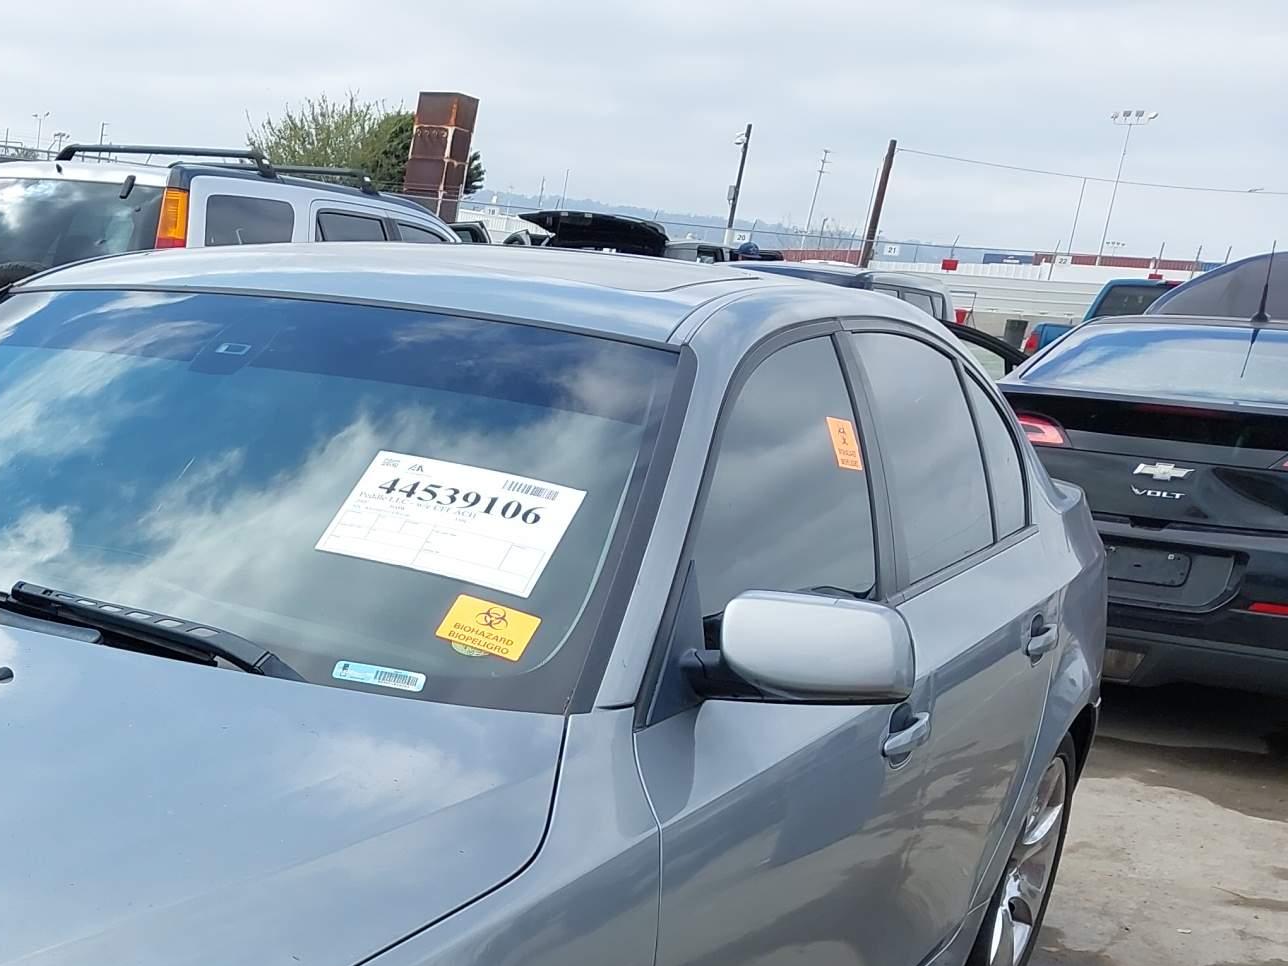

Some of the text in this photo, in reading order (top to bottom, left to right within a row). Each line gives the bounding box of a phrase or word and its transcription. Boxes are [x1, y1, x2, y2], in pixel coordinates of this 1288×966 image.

[887, 246, 897, 254] 21
[378, 477, 545, 525] 44539106
[1131, 484, 1186, 499] VOLT
[447, 630, 510, 655] BIOPELIGRO
[453, 621, 514, 647] BIOHAZARD
